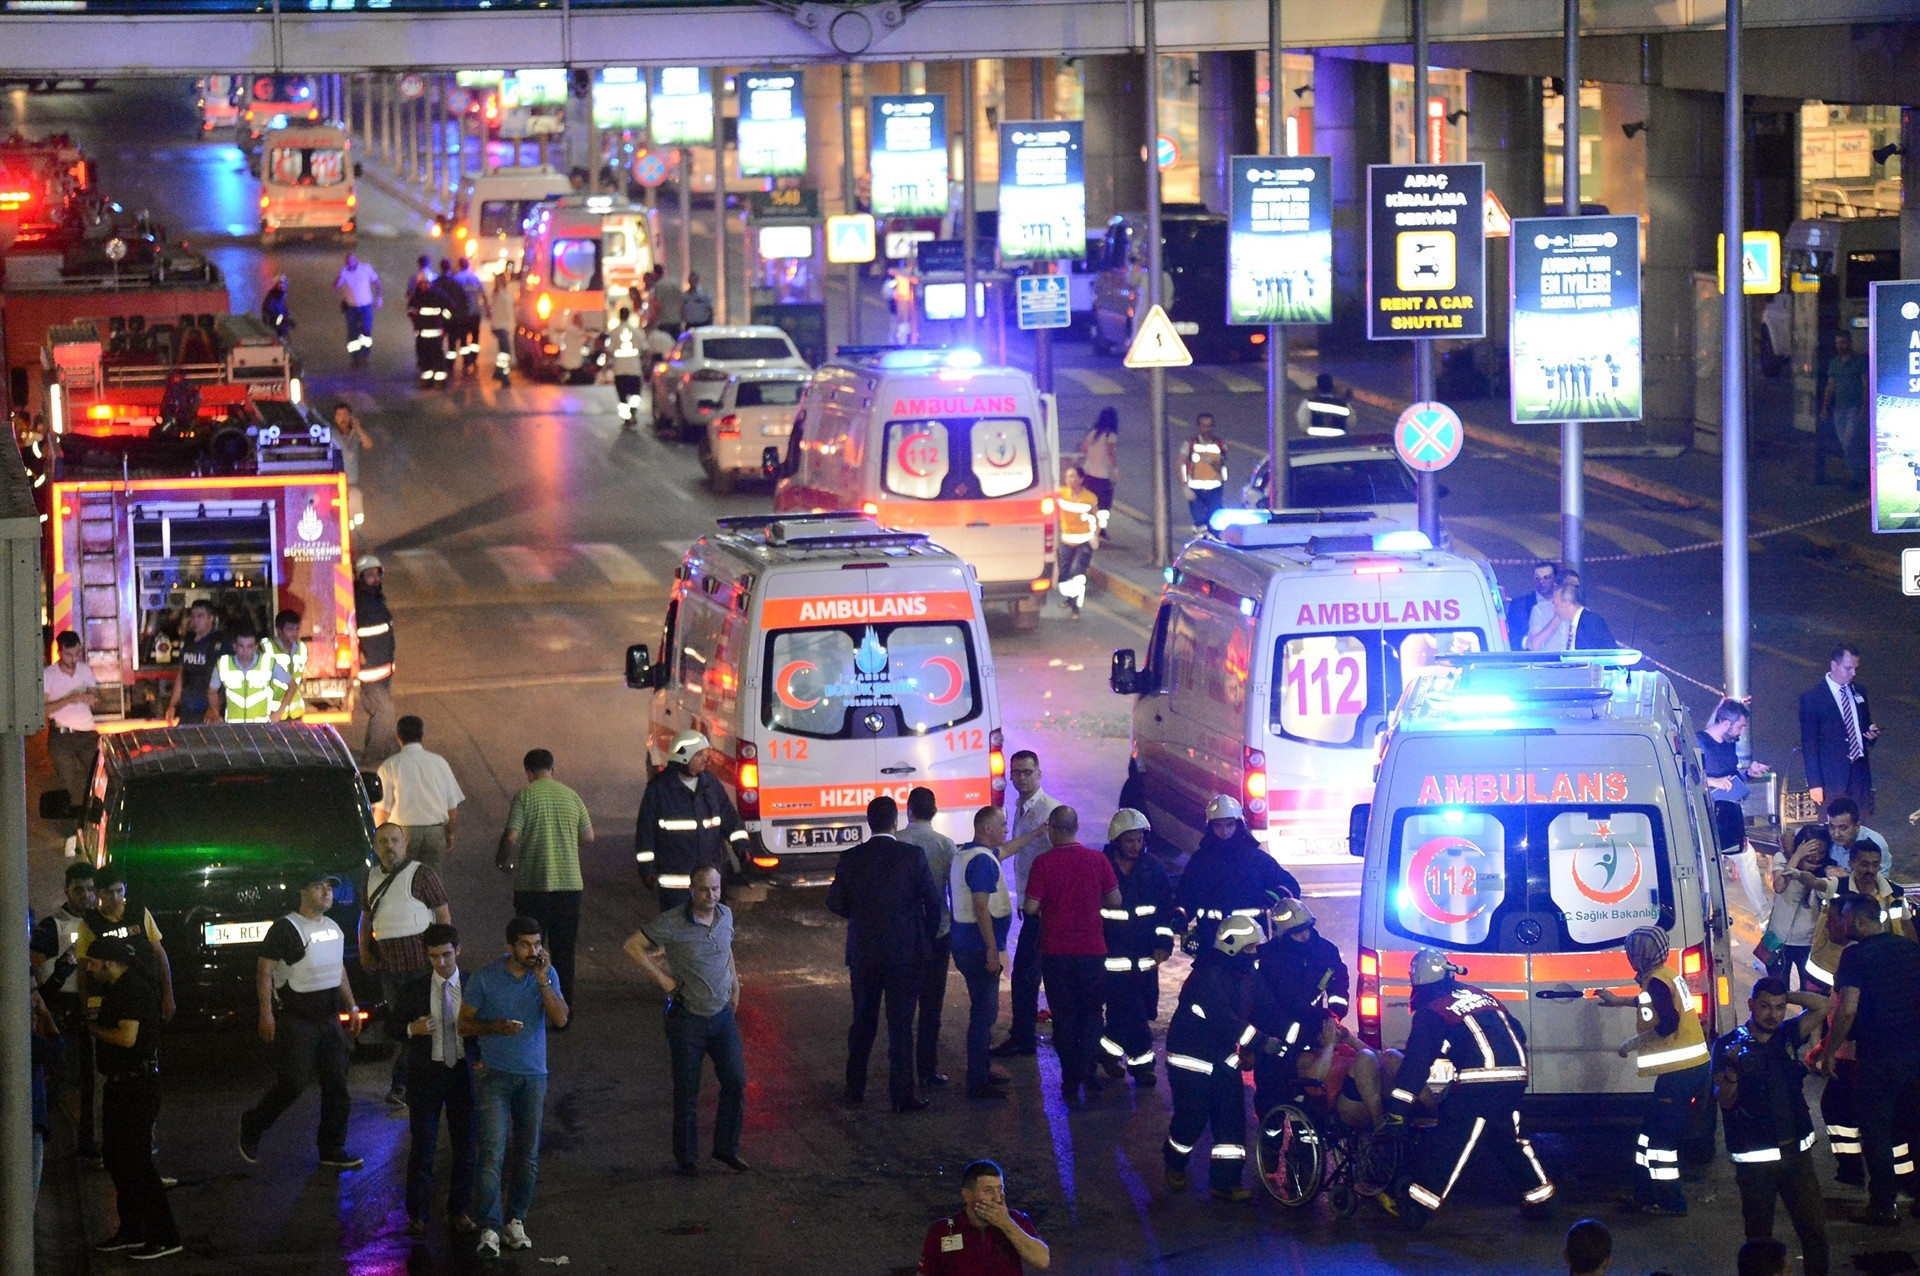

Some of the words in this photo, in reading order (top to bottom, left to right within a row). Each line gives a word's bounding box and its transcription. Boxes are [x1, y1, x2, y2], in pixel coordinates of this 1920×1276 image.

[1404, 174, 1448, 190] ARAÇ
[1386, 192, 1468, 207] KİRALAMA
[1380, 297, 1423, 311] RENT
[1425, 297, 1438, 310] A
[1440, 296, 1473, 309] CAR
[1391, 315, 1463, 329] SHUTTLE
[893, 397, 1017, 416] AMBULANS
[908, 448, 939, 464] 112
[799, 597, 927, 622] AMBULANS
[1296, 599, 1461, 626] AMBULANS
[183, 652, 206, 665] POLİS
[1288, 657, 1363, 716] 112
[945, 729, 984, 751] 112
[767, 738, 809, 760] 112
[820, 789, 876, 807] HIZIR
[882, 783, 913, 802] ACİ
[1417, 772, 1629, 805] AMBULANS
[792, 830, 807, 844] 34
[812, 829, 838, 843] FTV
[843, 828, 859, 842] 08
[1428, 865, 1477, 896] 112
[1576, 911, 1608, 922] Sağlık
[216, 928, 229, 941] 34
